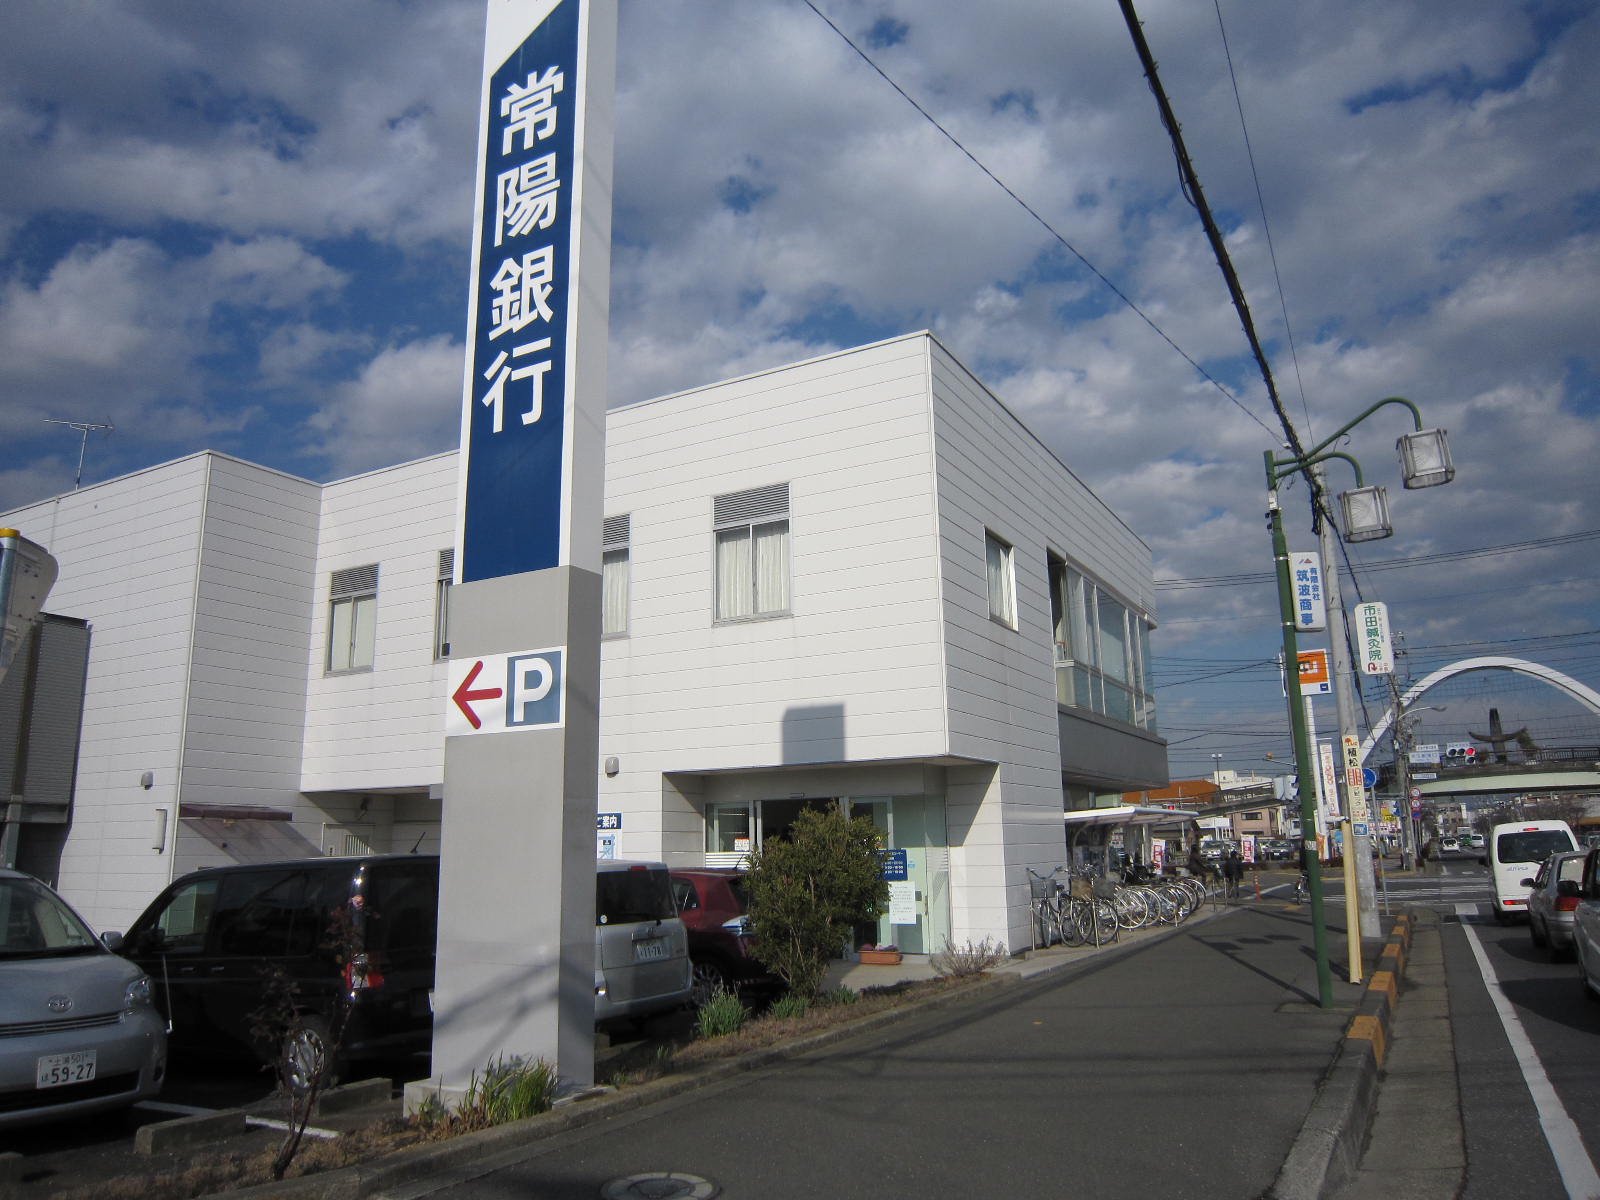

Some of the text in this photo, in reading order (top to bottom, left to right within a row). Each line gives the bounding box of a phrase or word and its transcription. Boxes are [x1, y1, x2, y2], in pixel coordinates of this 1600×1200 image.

[481, 64, 565, 434] 常陽銀行
[1296, 569, 1314, 626] 筑波商事
[513, 657, 553, 723] P
[1347, 747, 1358, 767] 植松
[51, 1063, 93, 1083] 59-27
